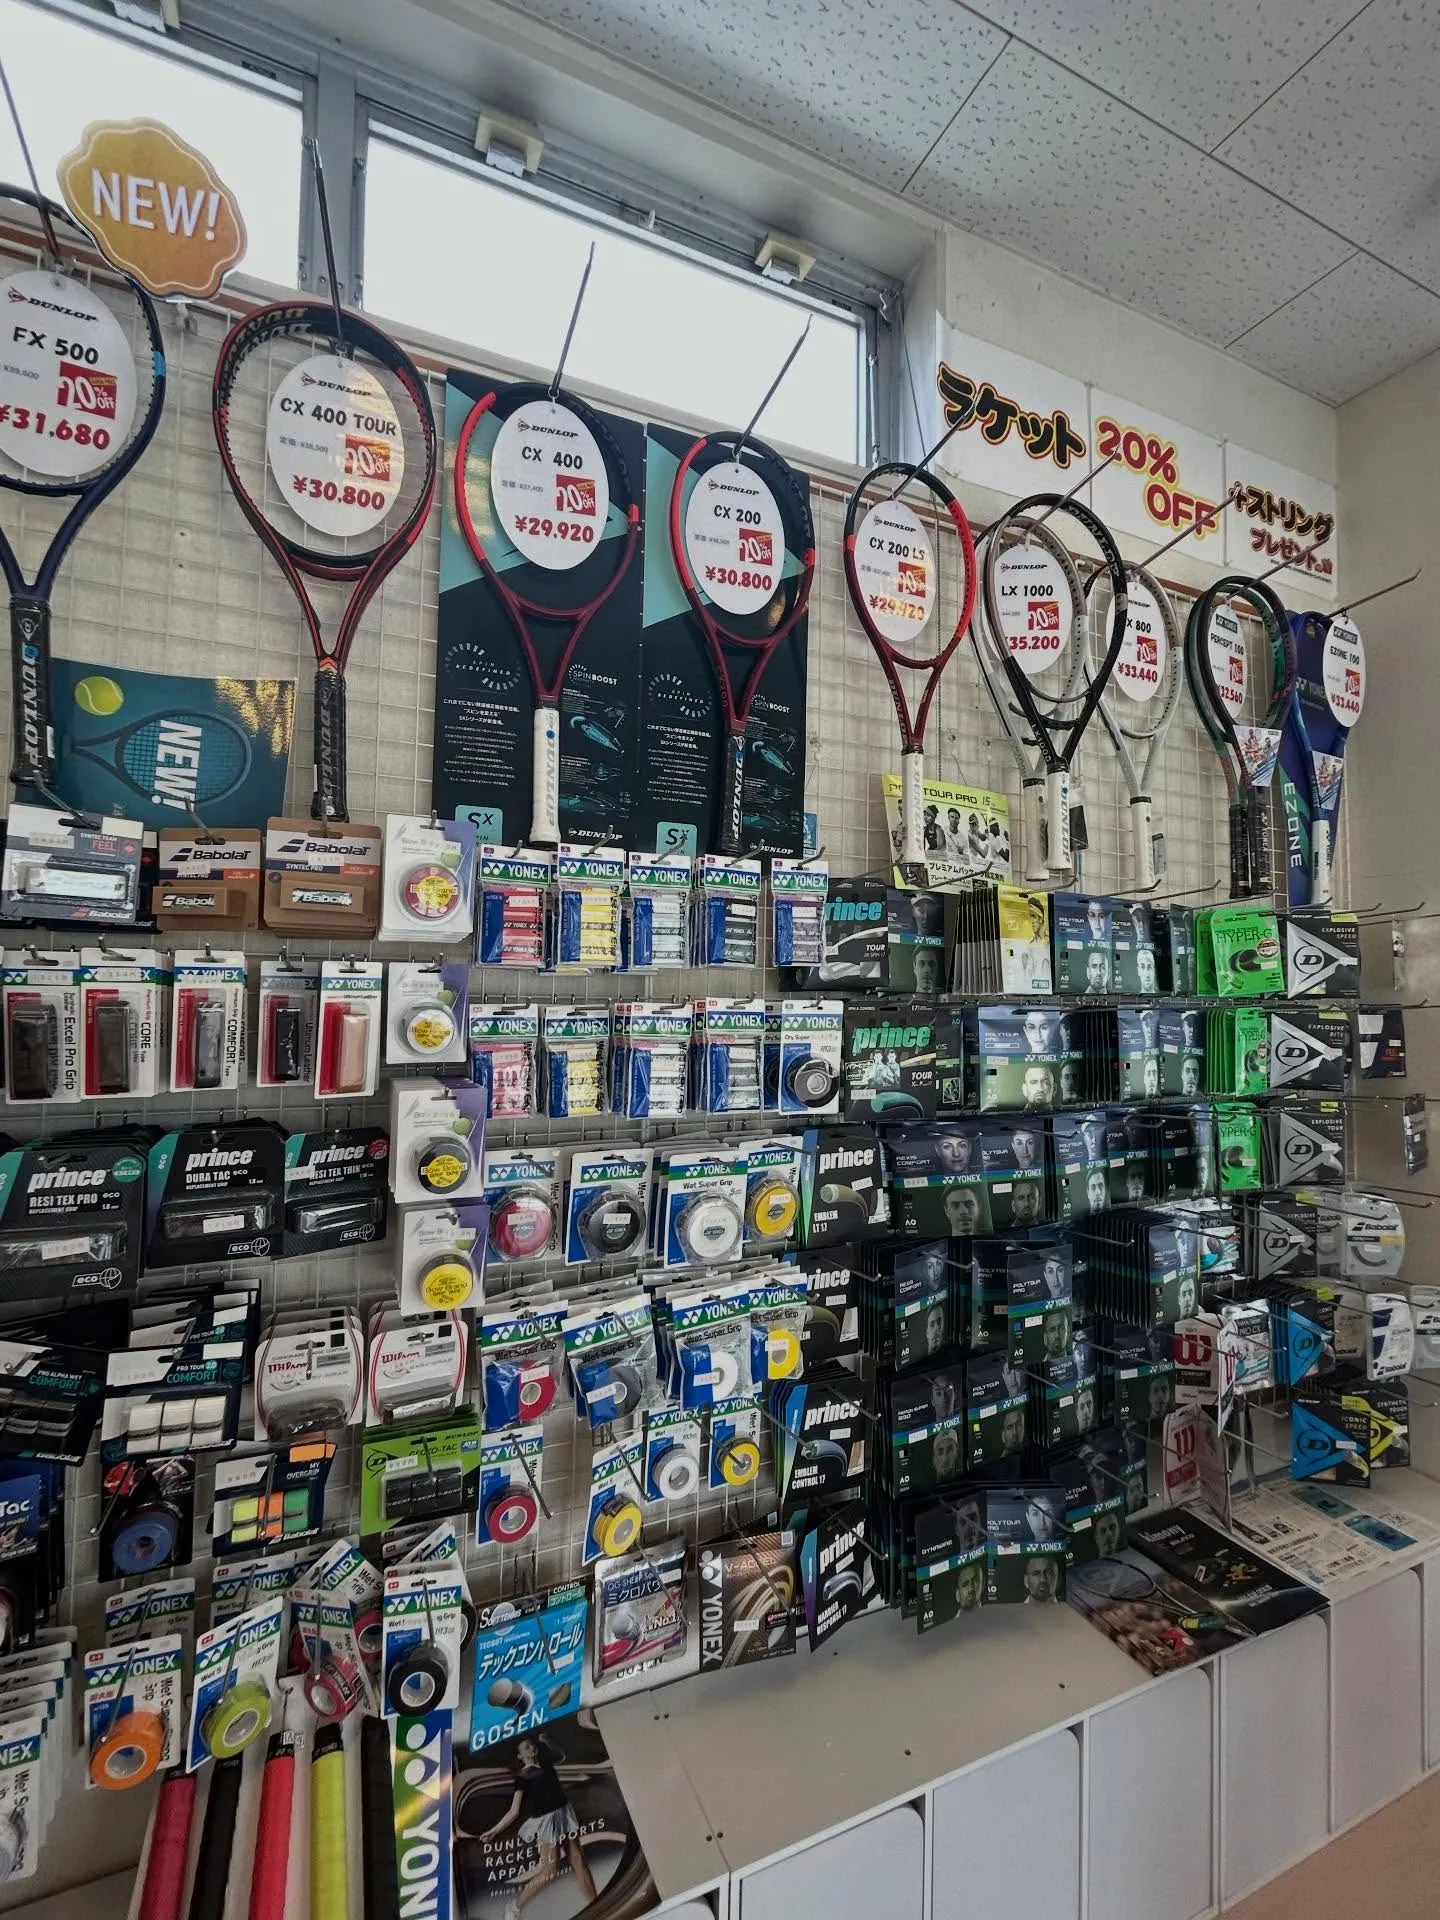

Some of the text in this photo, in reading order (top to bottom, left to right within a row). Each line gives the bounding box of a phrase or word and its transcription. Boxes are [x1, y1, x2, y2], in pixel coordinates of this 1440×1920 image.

[91, 168, 220, 241] NEW!
[27, 297, 99, 322] DUNLOP
[13, 326, 99, 365] FX 500
[316, 380, 373, 397] DUNLOP
[280, 397, 397, 436] CX 400 TOUR
[938, 361, 1087, 469] ラケット
[530, 423, 579, 438] DUNLOP
[521, 445, 583, 470] CX 400
[1098, 420, 1177, 484] 20%
[719, 483, 760, 496] DUNLOP
[713, 504, 761, 525] CX 200
[1146, 483, 1217, 535] OFF
[883, 519, 916, 532] DUNLOP
[869, 536, 925, 560] CX 200 LS
[1011, 563, 1048, 571] DUNLOP
[1001, 584, 1054, 597] LX 1000
[1135, 619, 1152, 633] 800
[1210, 632, 1244, 656] PERCEPT 100
[1330, 645, 1360, 665] EZONE 100
[22, 642, 41, 767] DUNLOP
[151, 719, 203, 810] NEW!
[732, 750, 745, 841] DUNLOP
[923, 787, 978, 805] TOUR PRO
[1283, 781, 1303, 868] EZONE
[577, 829, 623, 841] DUNLOP
[93, 840, 117, 852] FEEL
[285, 862, 324, 872] SYNTEC PRO
[508, 864, 545, 880] YONEX
[584, 861, 621, 877] YONEX
[653, 869, 688, 885] YONEX
[727, 872, 758, 887] YONEX
[793, 874, 825, 888] YONEX
[925, 937, 942, 945] YONEX
[1216, 928, 1273, 944] HYPER-G
[865, 943, 886, 952] TOUR
[1094, 941, 1111, 949] YONEX
[345, 978, 377, 989] YONEX
[496, 1020, 535, 1033] YONEX
[570, 1021, 606, 1034] YONEX
[654, 1019, 688, 1032] YONEX
[729, 1014, 762, 1028] YONEX
[805, 1015, 840, 1030] YONEX
[141, 1021, 151, 1049] CORE
[227, 1018, 237, 1065] COMFORT
[853, 1020, 931, 1056] prince
[63, 1016, 77, 1091] Excel Pro Grip
[1036, 1054, 1057, 1062] YONEX
[911, 1070, 933, 1080] TOUR
[157, 1153, 168, 1169] eco
[185, 1147, 253, 1172] prince
[309, 1143, 365, 1171] prince
[764, 1152, 792, 1164] YONEX
[819, 1147, 874, 1174] prince
[186, 1168, 248, 1184] DURA TAC eco
[328, 1164, 360, 1179] TEX THIN
[421, 1167, 441, 1175] Bow
[605, 1164, 640, 1178] YONEX
[1023, 1168, 1042, 1178] YONEX
[27, 1166, 107, 1193] prince
[683, 1178, 733, 1190] Wet Super Grip
[956, 1174, 982, 1184] YONEX
[29, 1191, 120, 1208] RESI TEX PRO eco
[814, 1210, 839, 1222] EMBLEM
[812, 1222, 828, 1233] LT 17
[231, 1243, 250, 1252] eco
[76, 1275, 99, 1284] eco
[425, 1281, 468, 1295] Bow Brand
[766, 1288, 799, 1302] YONEX
[1055, 1296, 1071, 1307] YONEX
[519, 1317, 558, 1338] YONEX
[600, 1312, 642, 1336] YONEX
[687, 1322, 742, 1344] Wet Super Grip
[381, 1351, 421, 1364] Wilson
[1013, 1348, 1024, 1357] AO
[29, 1375, 80, 1390] COMFORT
[49, 1371, 69, 1379] ALPHA
[166, 1370, 218, 1384] COMFORT
[804, 1398, 861, 1431] prince
[943, 1416, 960, 1428] YONEX
[1341, 1416, 1368, 1424] ICONIC
[309, 1462, 320, 1470] MY
[794, 1465, 818, 1479] EMBLEM
[286, 1469, 320, 1480] OVERGRIP
[792, 1473, 826, 1490] CONTROL 17
[819, 1521, 865, 1574] prince
[967, 1546, 985, 1560] YONEX
[1040, 1542, 1062, 1551] YONEX
[321, 1553, 358, 1590] YONEX
[553, 1581, 581, 1594] CONTROL
[702, 1592, 724, 1664] YONEX
[472, 1709, 545, 1751] GOSEN
[486, 1843, 541, 1868] RACKET
[487, 1857, 557, 1882] APPAREL
